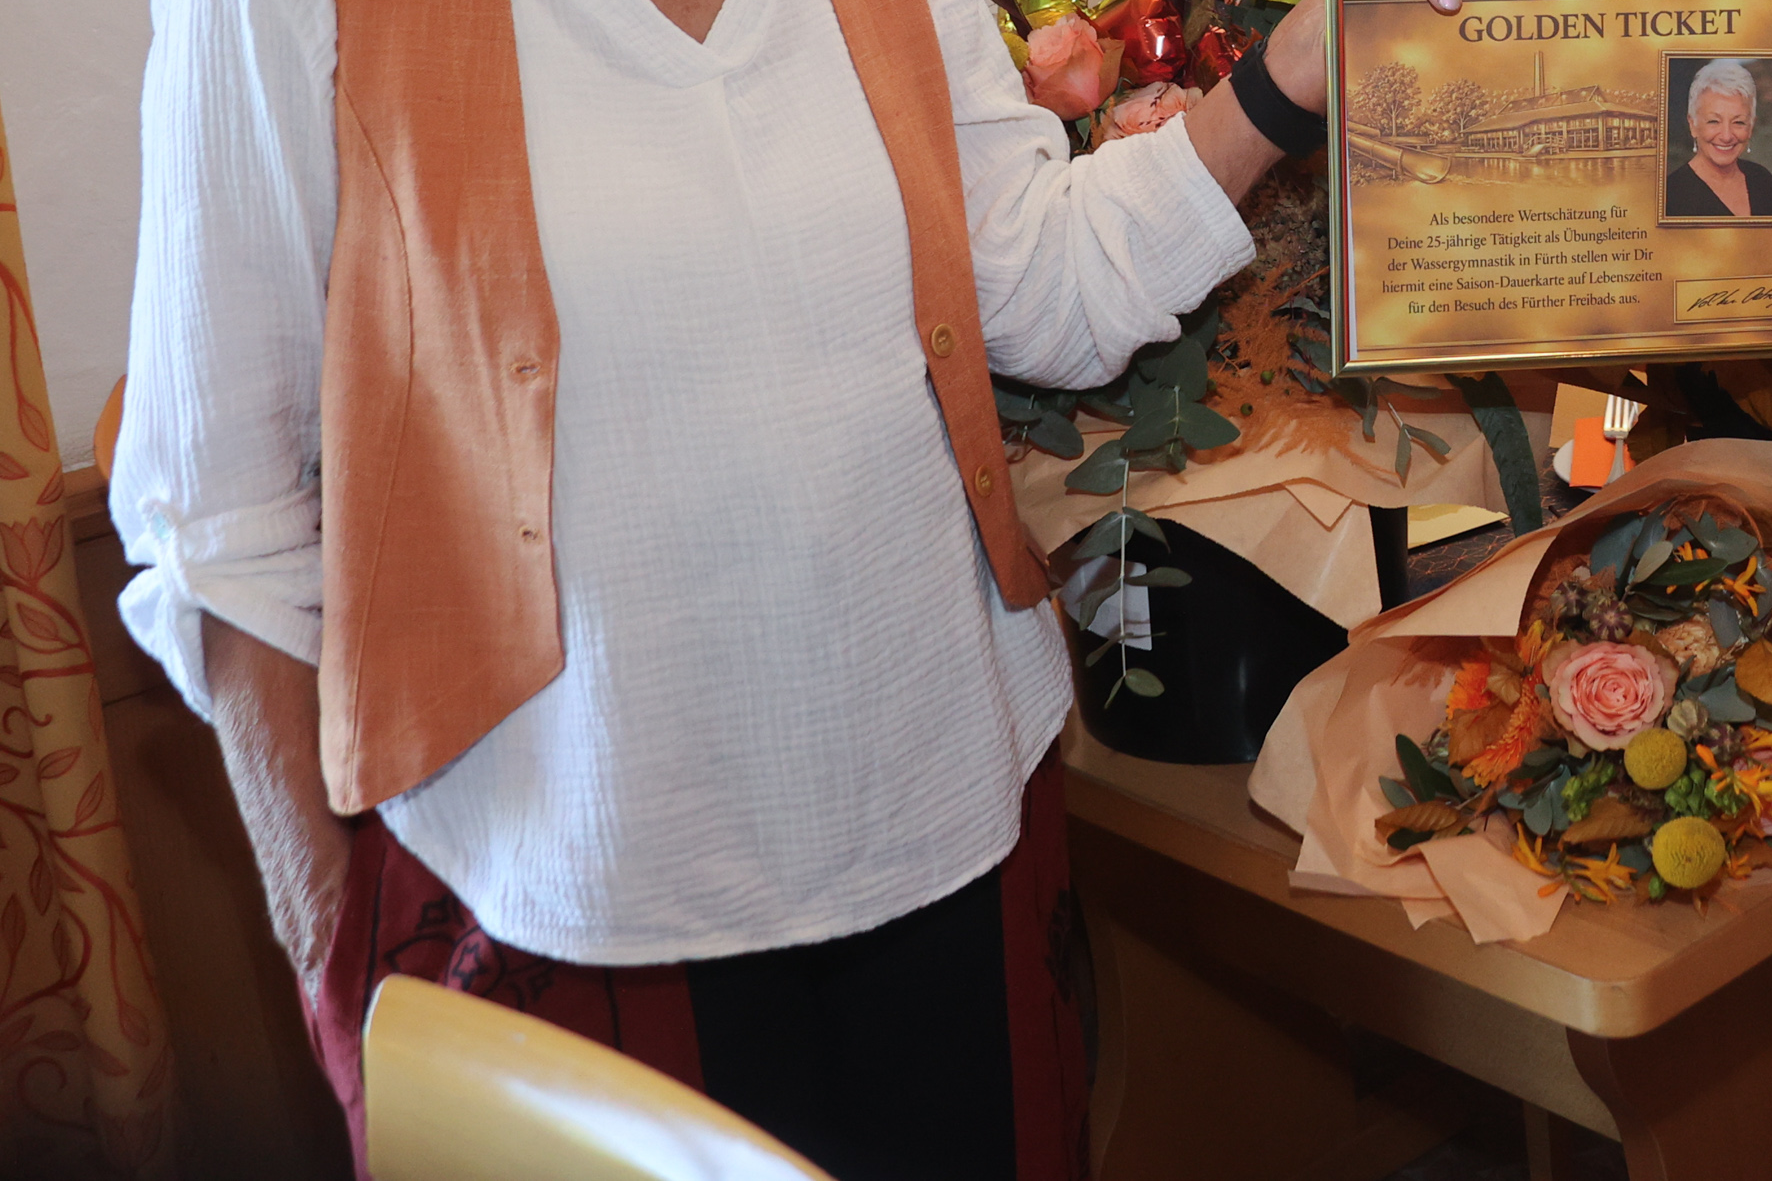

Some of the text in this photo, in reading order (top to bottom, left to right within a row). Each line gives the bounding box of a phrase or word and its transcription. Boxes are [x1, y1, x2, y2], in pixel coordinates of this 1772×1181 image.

[1458, 8, 1741, 43] GOLDEN TICKET
[1429, 204, 1629, 226] Als besondere Wertschätzung für
[1387, 227, 1648, 251] Deine 25-jährige Tätigkeit als Übungsleiterin
[1387, 248, 1654, 272] der Wassergymnastik in Fürth stellen wir Dir
[1381, 269, 1663, 294] hiermit eine Saison-Dauerkarte auf Lebenszeiten
[1407, 292, 1641, 314] für den Besuch des Fürther Freibads aus.
